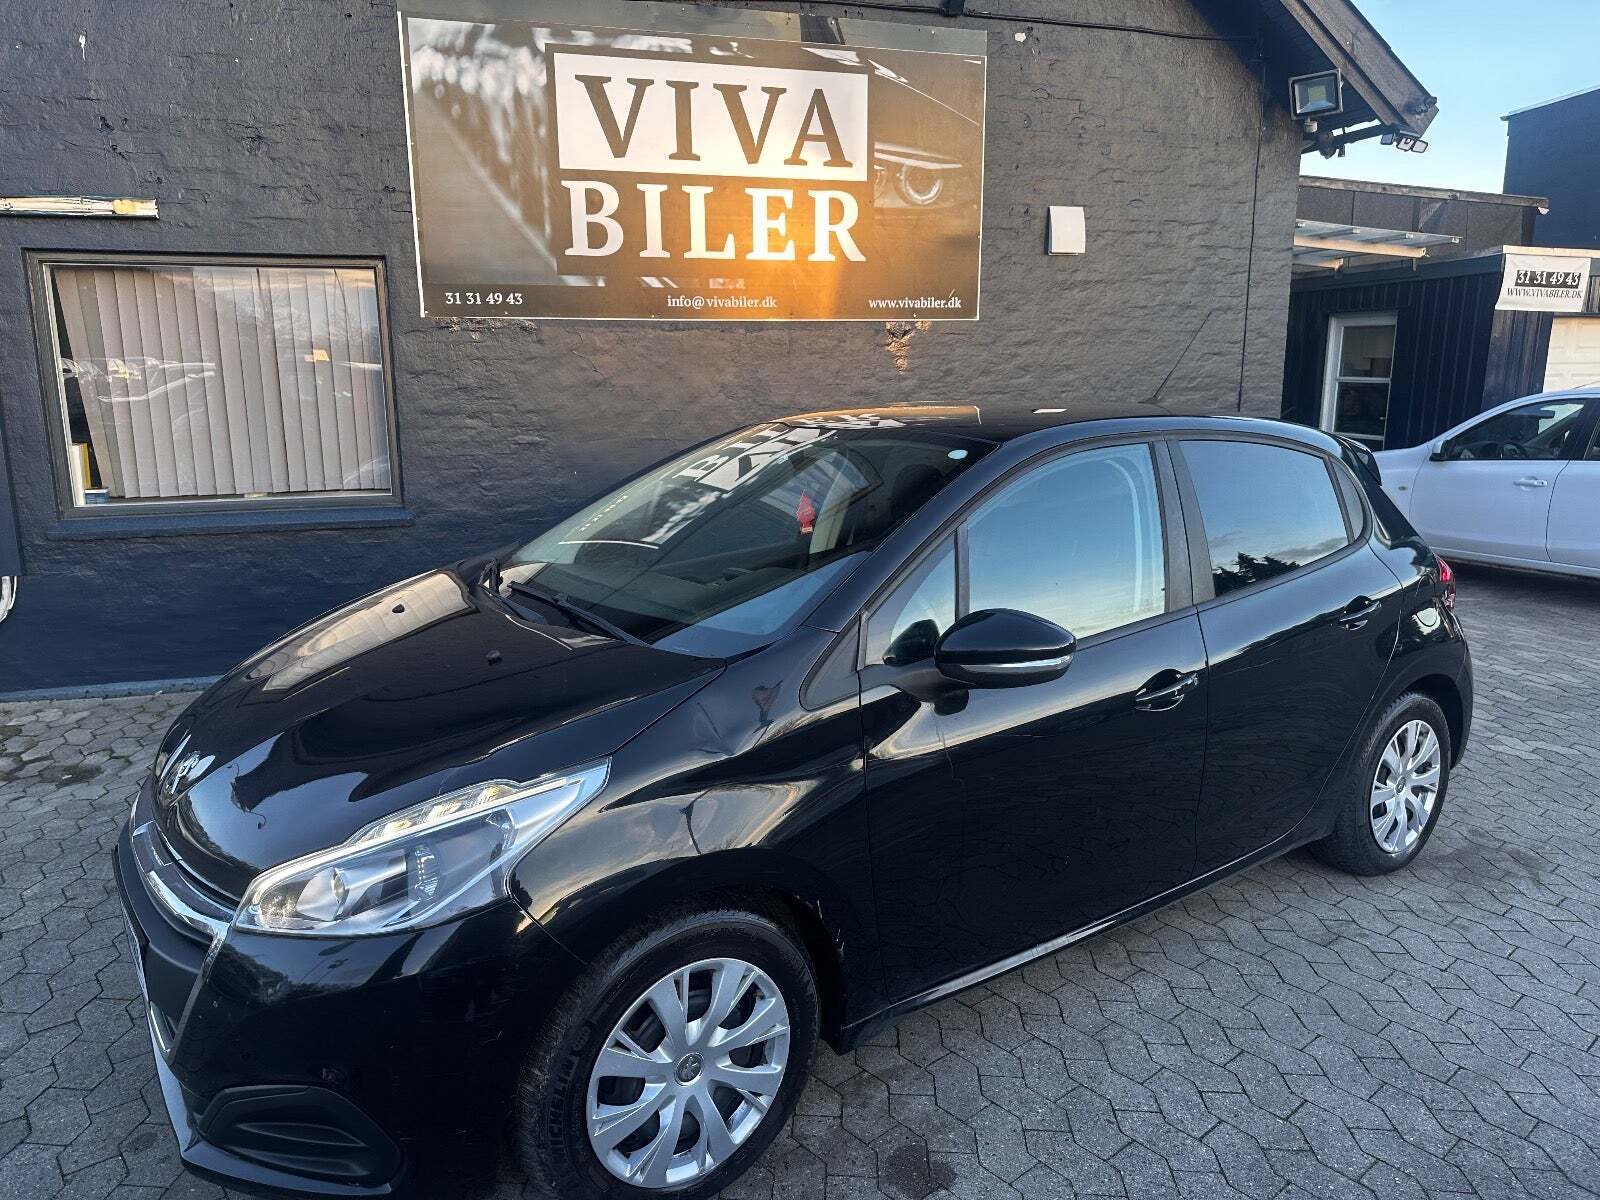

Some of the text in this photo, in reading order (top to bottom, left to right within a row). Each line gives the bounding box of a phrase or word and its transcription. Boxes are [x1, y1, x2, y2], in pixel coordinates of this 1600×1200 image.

[574, 74, 854, 168] VIVA
[559, 179, 867, 262] BILER
[1516, 270, 1580, 285] 31 31 49 43
[445, 292, 523, 305] 31 31 49 43
[868, 297, 962, 308] www.vivabiler.dk
